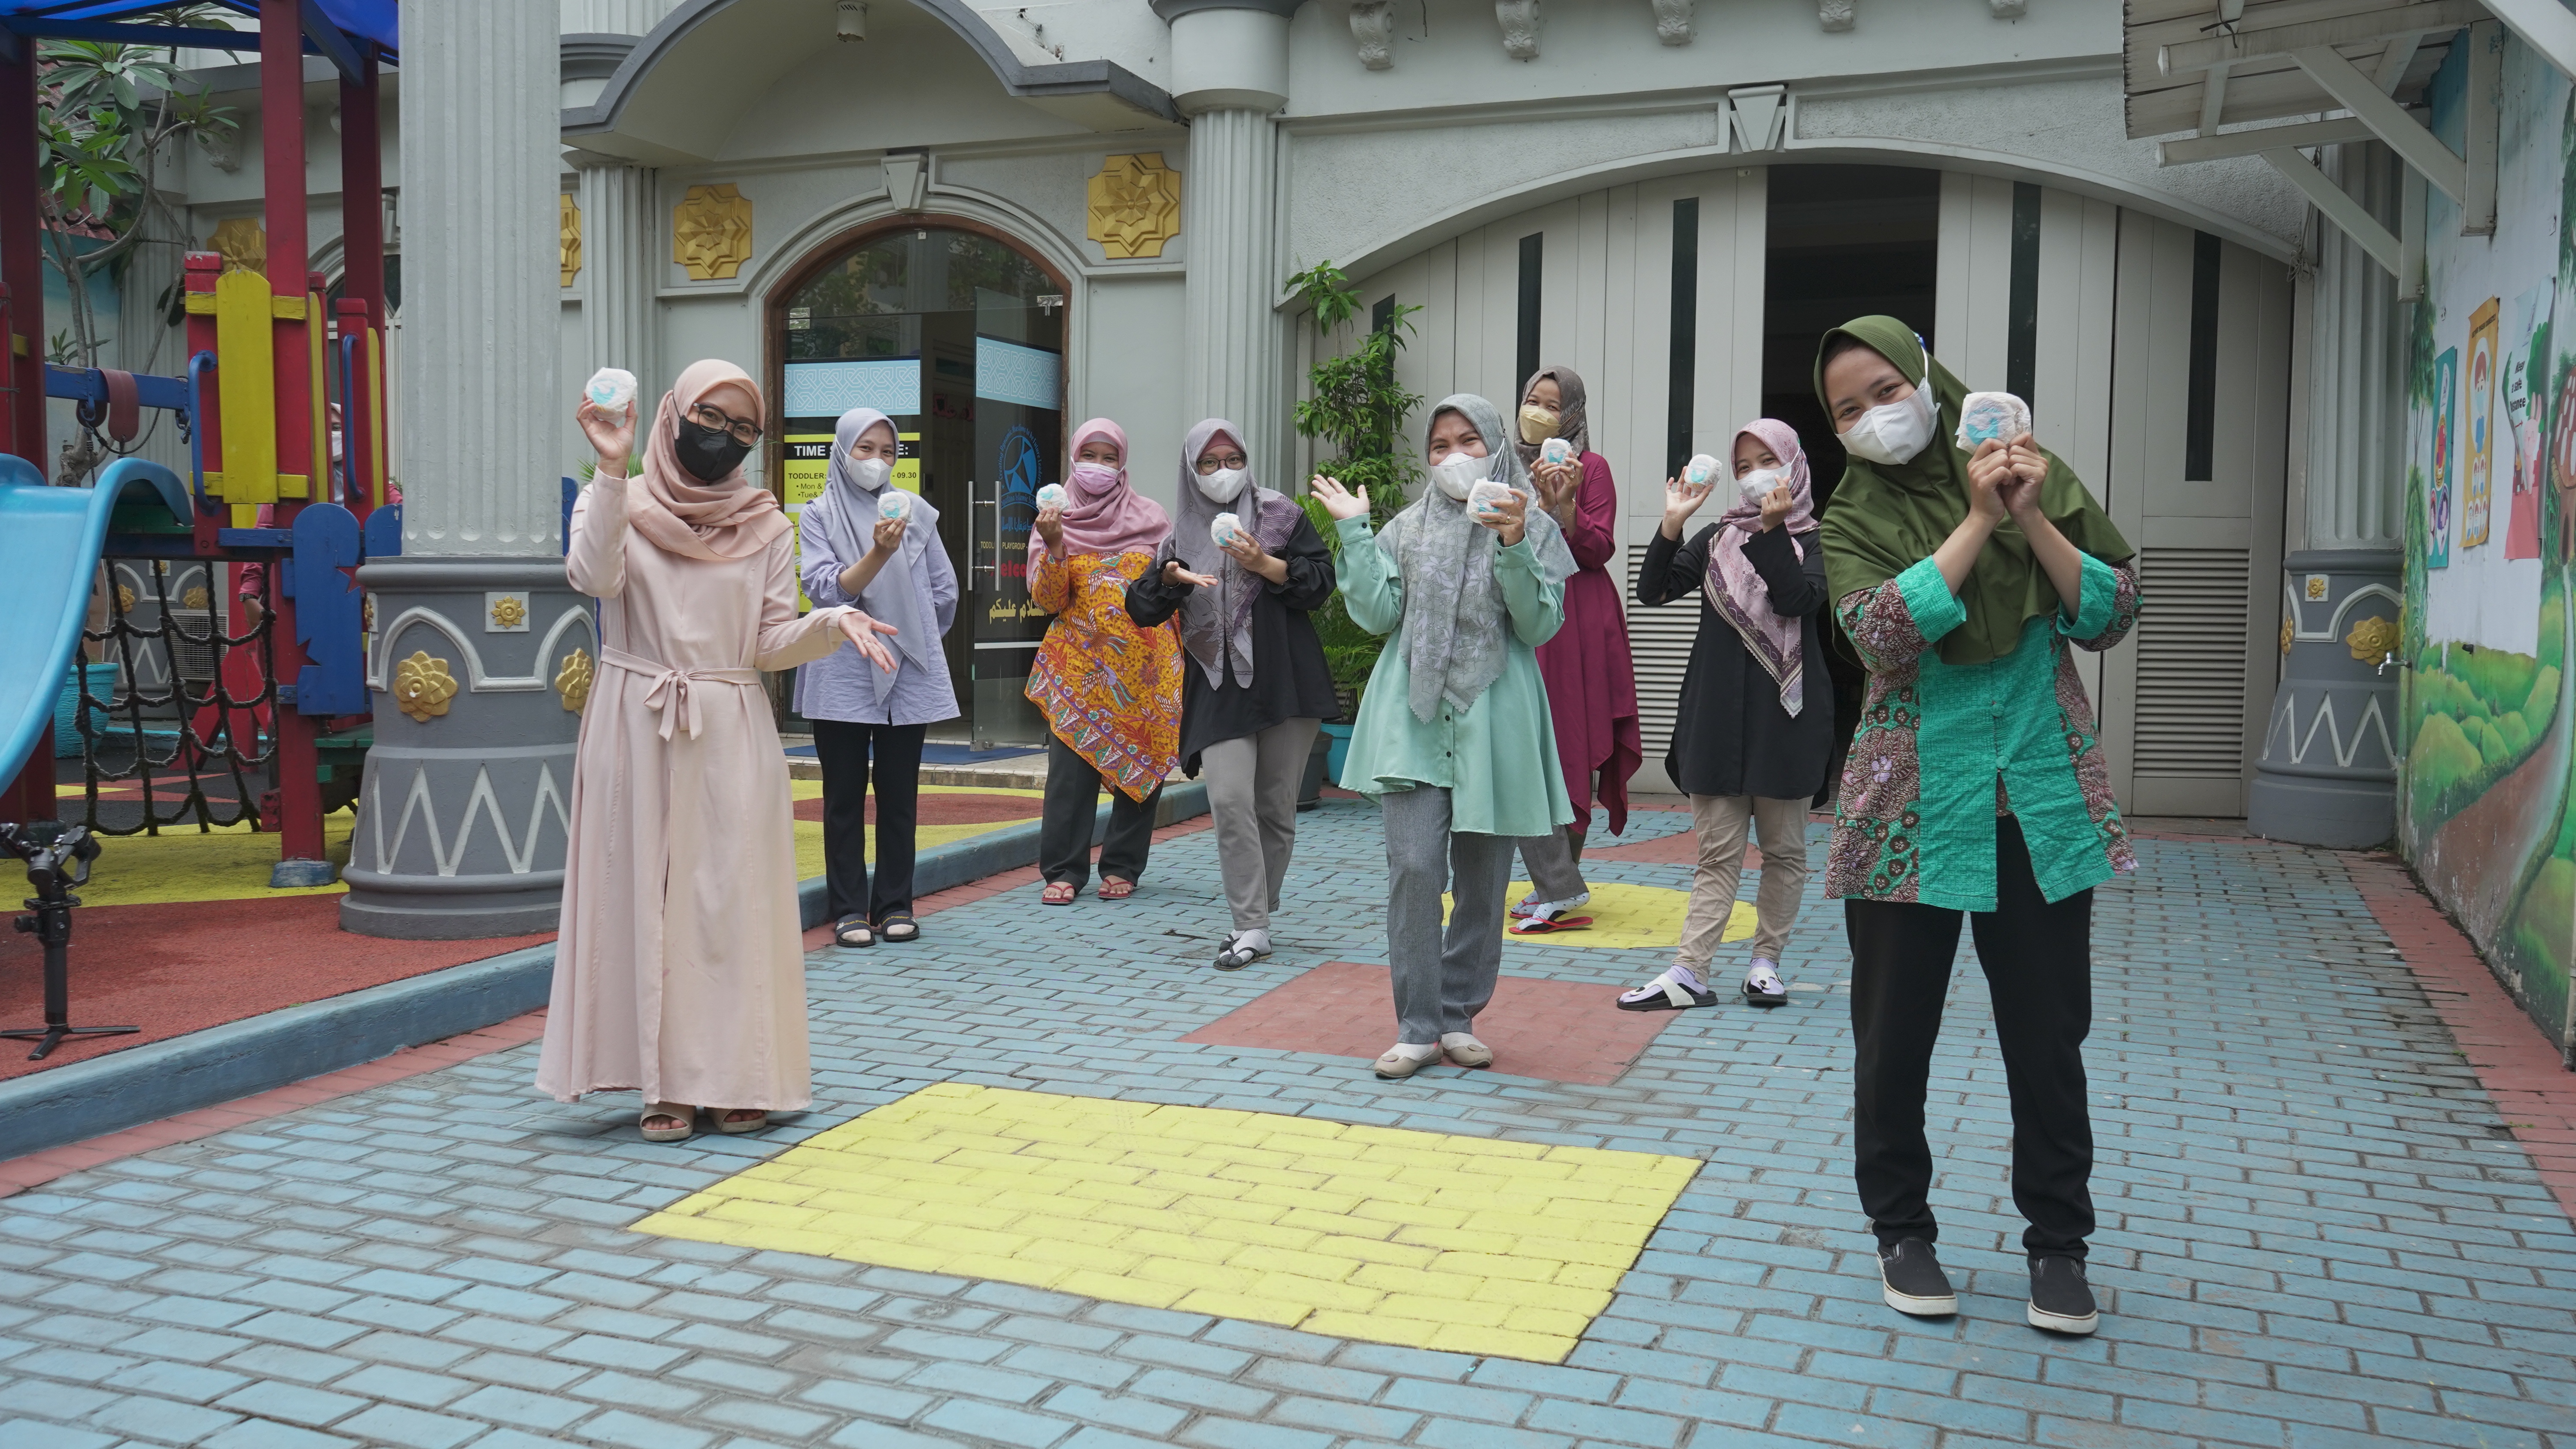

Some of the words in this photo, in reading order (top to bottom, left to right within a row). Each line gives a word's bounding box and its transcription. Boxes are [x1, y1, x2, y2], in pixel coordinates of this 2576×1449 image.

[2515, 361, 2525, 374] Keep
[794, 445, 826, 456] TIME
[990, 560, 1027, 577] elco
[989, 598, 1017, 624] عليكم
